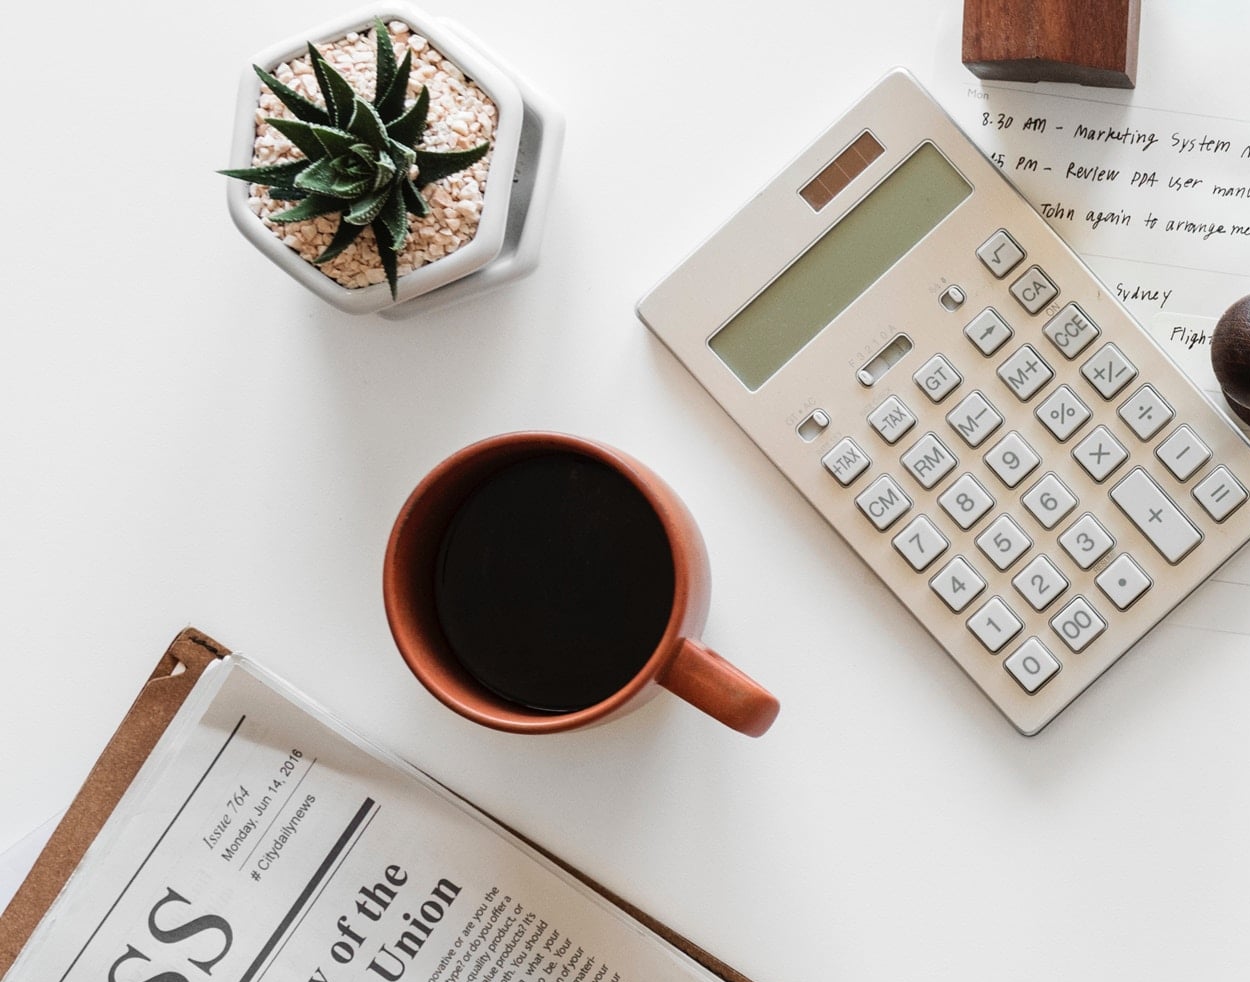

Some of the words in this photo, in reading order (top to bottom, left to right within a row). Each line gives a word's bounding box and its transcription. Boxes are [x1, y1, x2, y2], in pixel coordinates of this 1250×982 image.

[966, 88, 990, 100] Mon
[1021, 116, 1047, 134] AM
[1073, 123, 1159, 152] Marketing
[1170, 132, 1231, 154] System
[1014, 155, 1038, 172] PM
[1065, 161, 1120, 182] Review
[1167, 176, 1203, 192] user
[1084, 208, 1131, 230] again
[1143, 212, 1158, 229] to
[1164, 219, 1227, 241] arrange
[1021, 280, 1048, 302] CA
[1115, 282, 1173, 309] Sydney
[1045, 301, 1060, 316] ON
[924, 365, 948, 391] GT
[1006, 359, 1039, 390] M+
[912, 445, 945, 478] RM
[1001, 450, 1020, 470] 9
[867, 487, 900, 518] CM
[955, 491, 975, 512] 8
[1038, 491, 1058, 511] 6
[907, 532, 925, 554] 7
[992, 531, 1012, 553] 5
[1075, 531, 1095, 552] 3
[950, 574, 966, 594] 4
[1030, 573, 1050, 595] 2
[985, 616, 1002, 633] 1
[1061, 609, 1092, 640] 00
[202, 813, 232, 850] Issue
[225, 784, 250, 813] 764
[220, 817, 258, 862] Monday,
[253, 794, 272, 817] Jun
[278, 747, 303, 777] 2016
[256, 793, 316, 871] Citydailynews
[330, 914, 367, 964] of
[354, 863, 408, 922] the
[365, 877, 463, 982] Union
